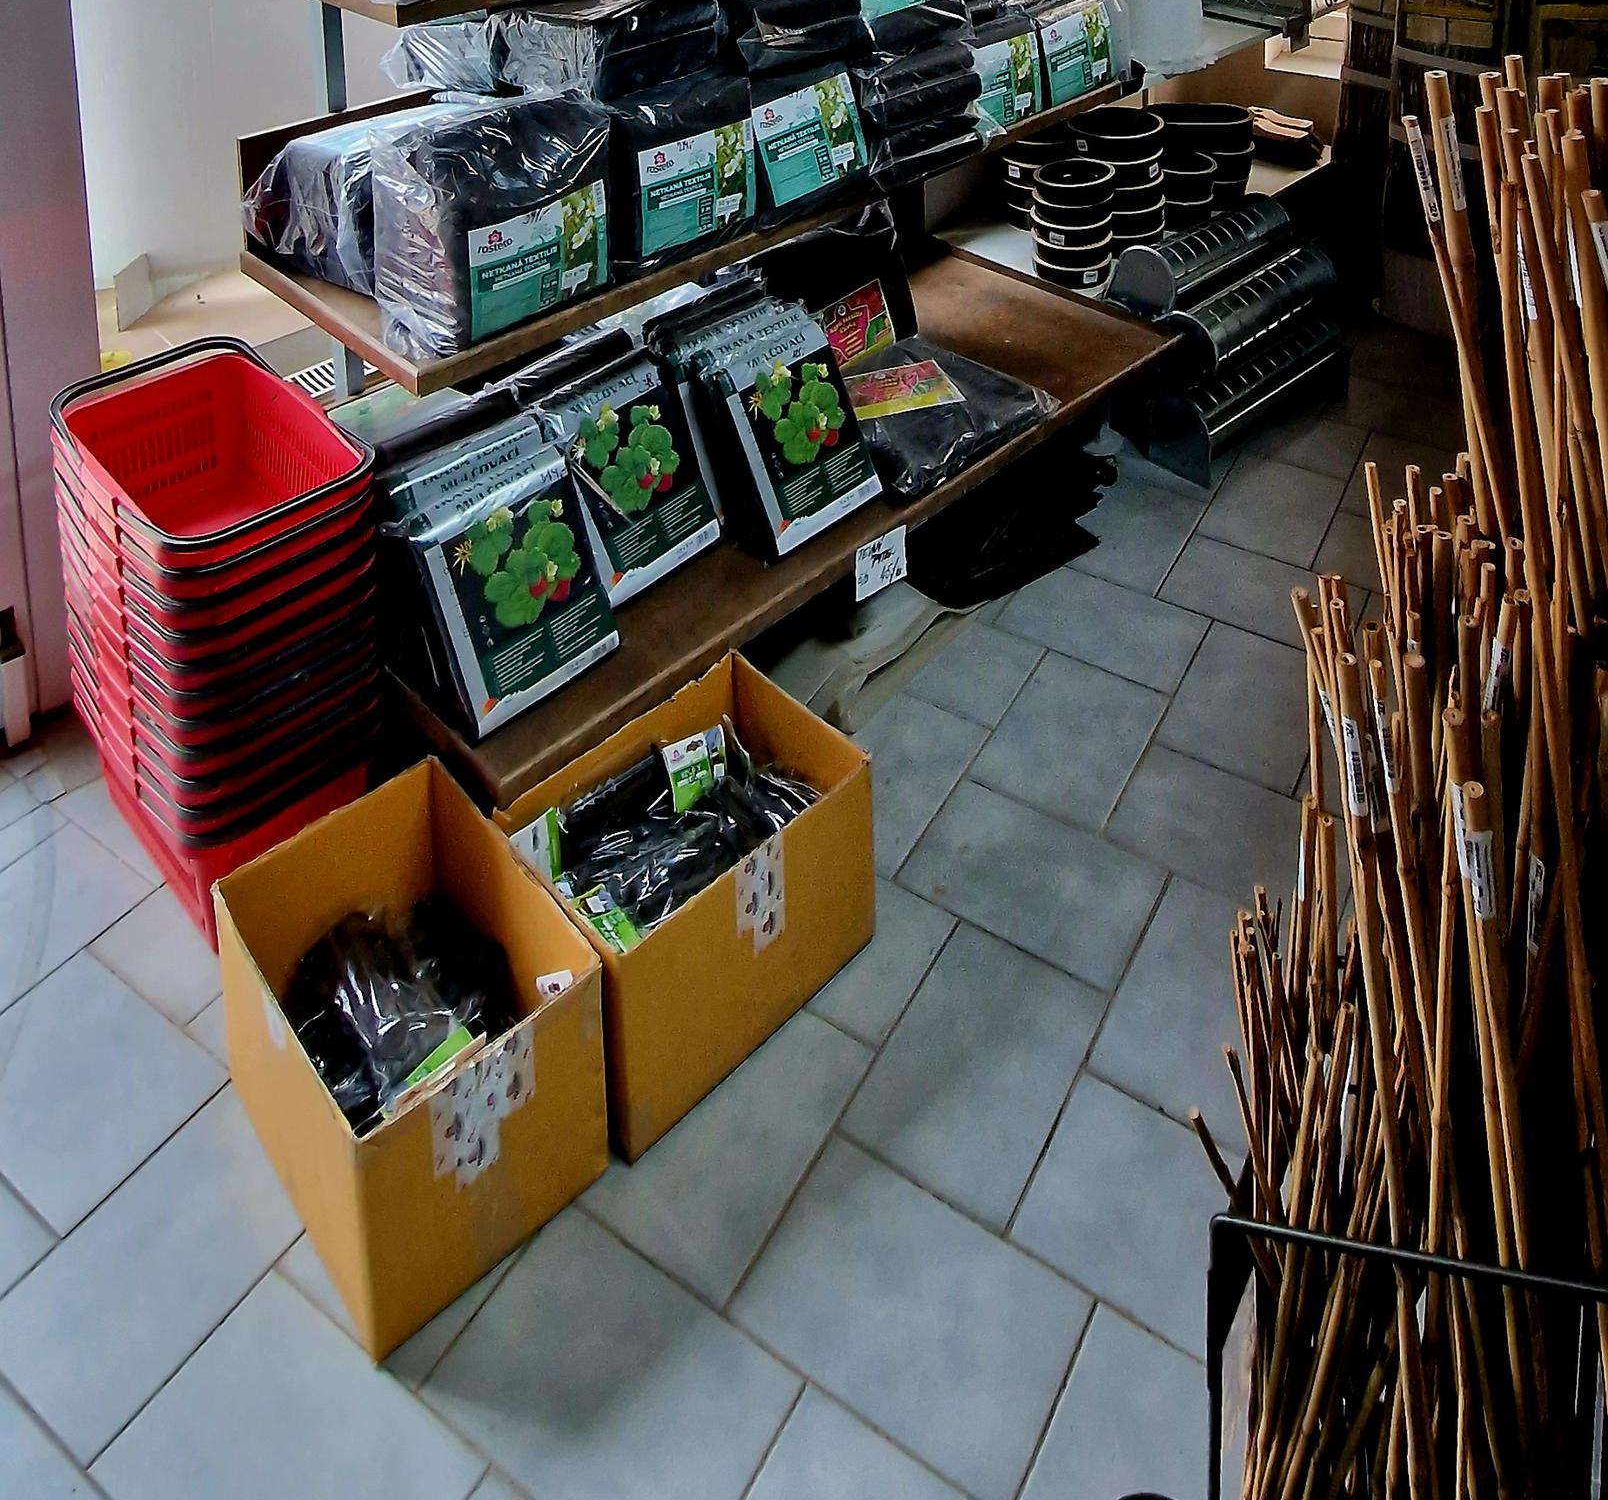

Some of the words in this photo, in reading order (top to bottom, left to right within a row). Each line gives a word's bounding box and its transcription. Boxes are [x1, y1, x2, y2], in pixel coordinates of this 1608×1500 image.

[477, 236, 513, 254] rosteto
[481, 258, 523, 280] NETKANÁ
[524, 245, 558, 265] TEXTILIE
